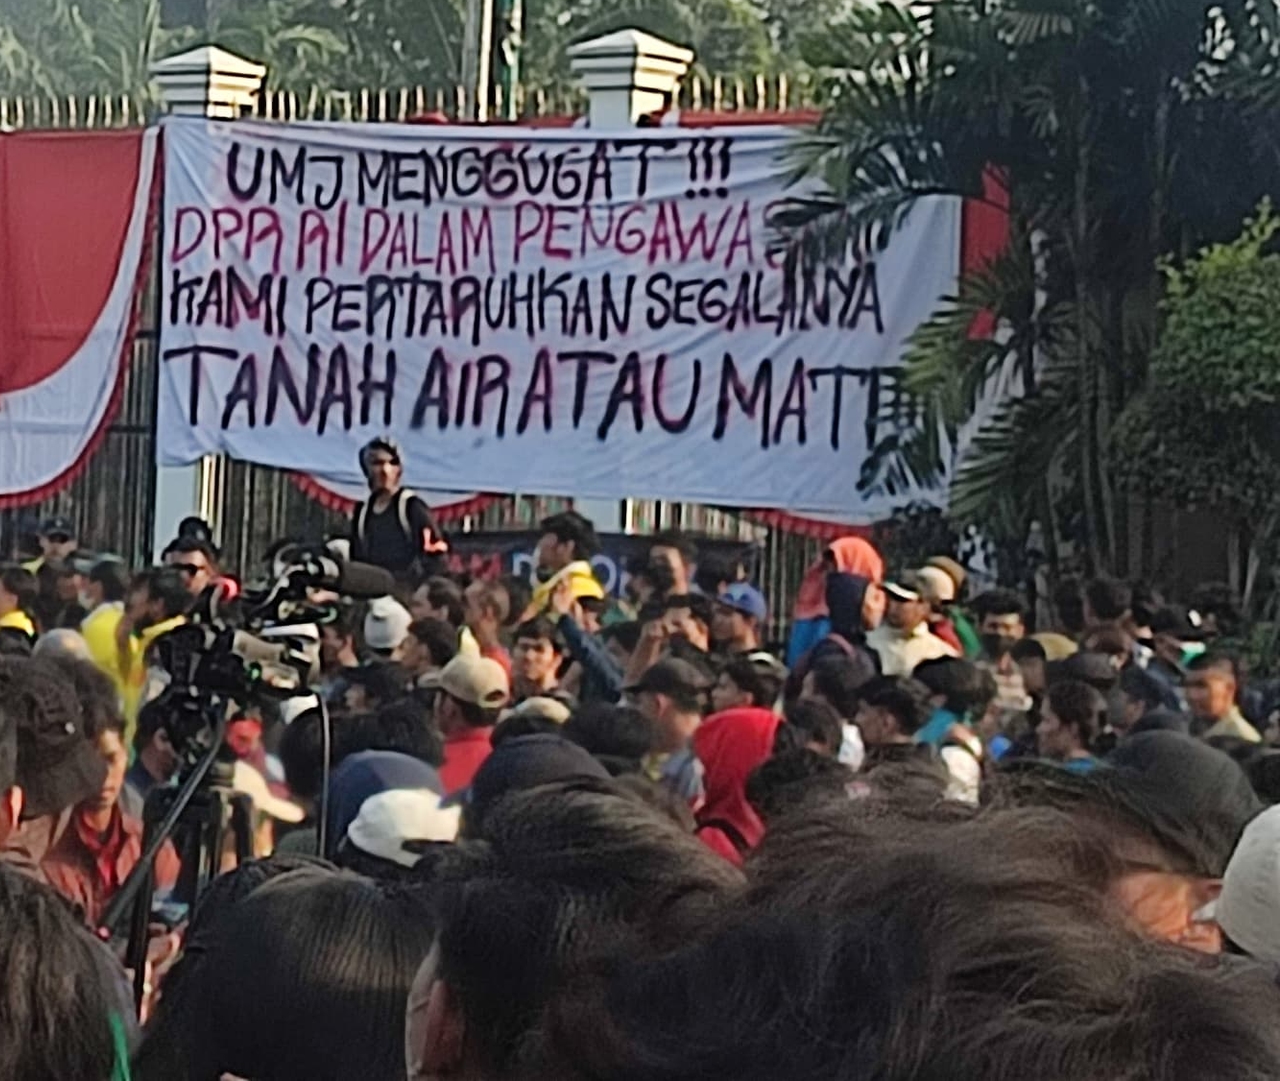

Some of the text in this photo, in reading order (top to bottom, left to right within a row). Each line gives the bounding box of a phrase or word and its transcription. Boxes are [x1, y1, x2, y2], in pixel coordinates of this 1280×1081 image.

[227, 142, 344, 211] UMJ
[358, 138, 679, 208] MENGGUGAT
[171, 206, 283, 275] DPR
[296, 199, 348, 278] RI
[359, 205, 496, 276] DALAM
[170, 262, 883, 346] KAMI PERTARUHKAN SEGALANYA
[163, 343, 396, 435] TANAH
[409, 346, 511, 438] AIR
[516, 347, 701, 442] ATAU
